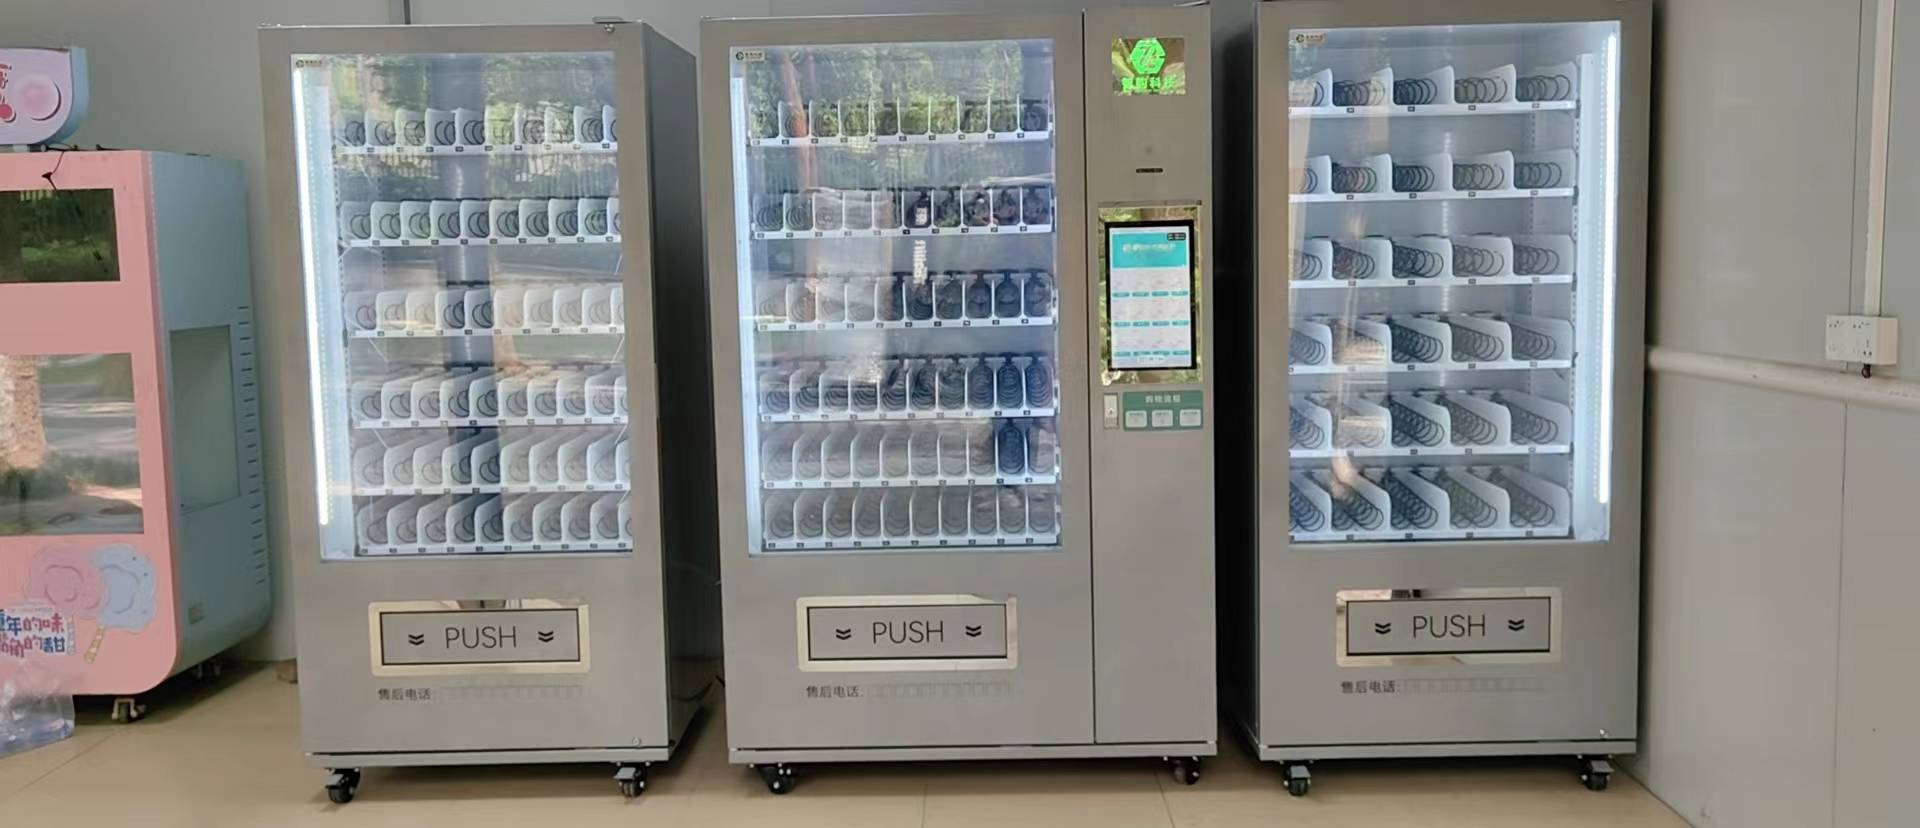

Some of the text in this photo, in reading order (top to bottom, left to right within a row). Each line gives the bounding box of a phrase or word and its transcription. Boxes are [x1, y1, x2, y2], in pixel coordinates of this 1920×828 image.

[445, 625, 517, 649] PUSH
[872, 620, 944, 644] PUSH
[1412, 614, 1486, 638] PUSH
